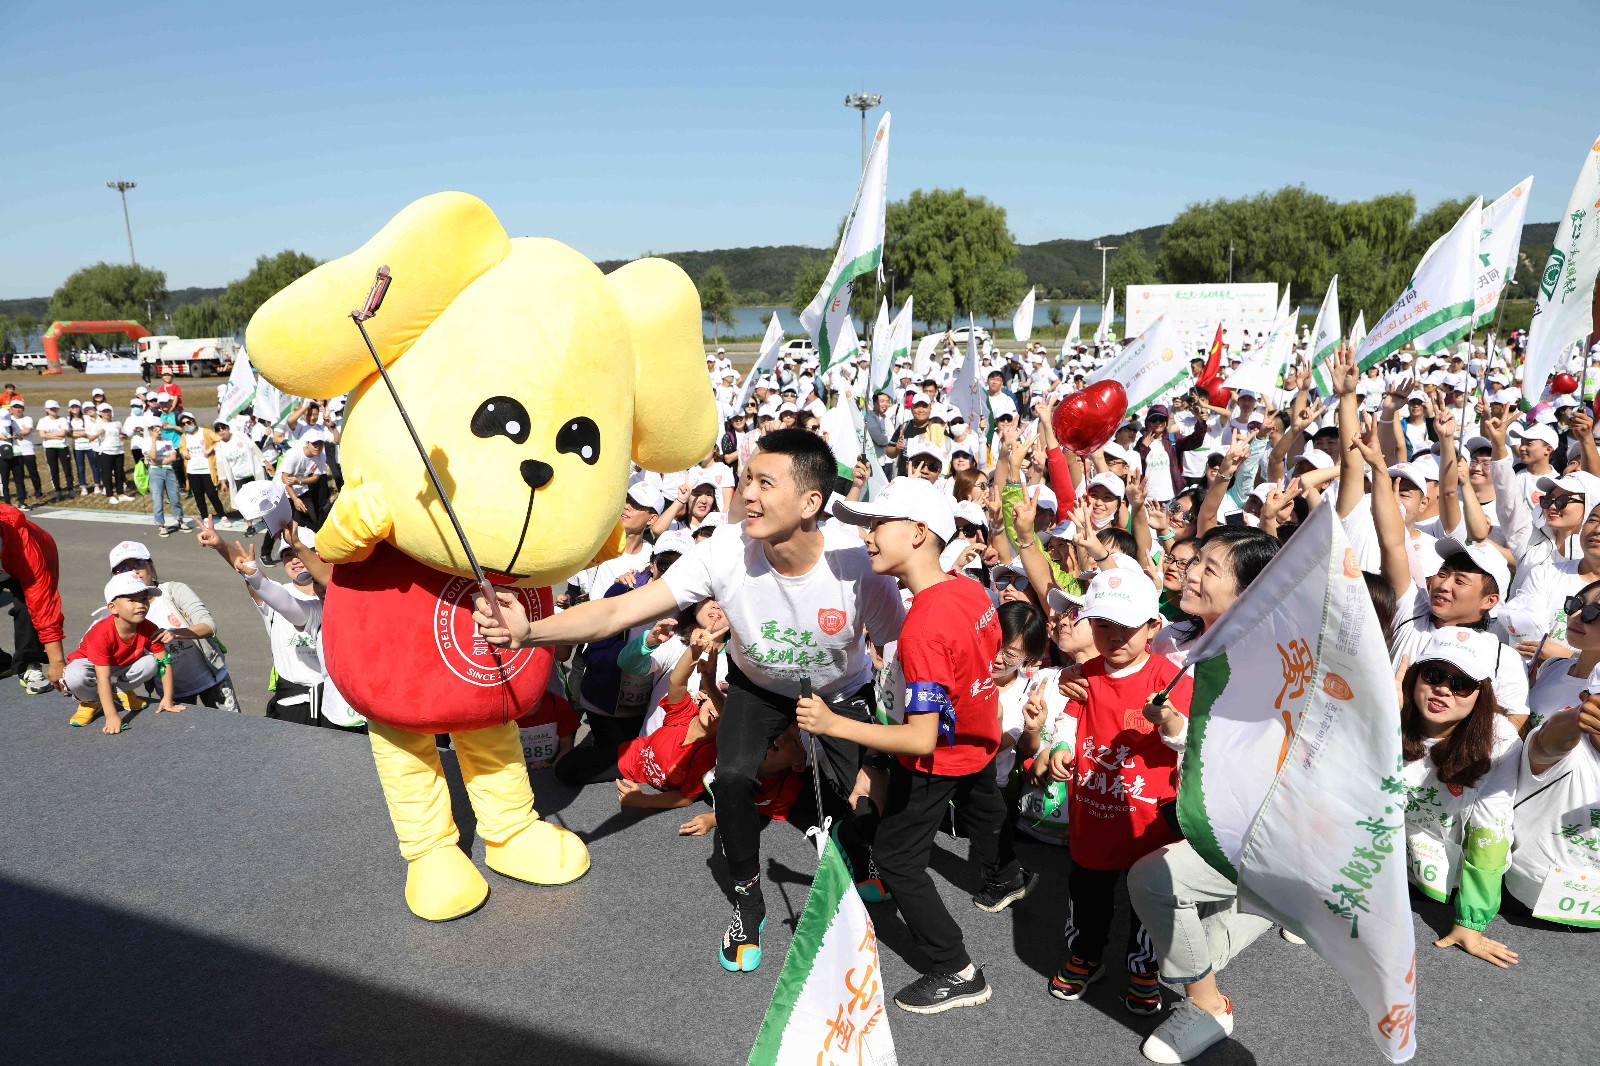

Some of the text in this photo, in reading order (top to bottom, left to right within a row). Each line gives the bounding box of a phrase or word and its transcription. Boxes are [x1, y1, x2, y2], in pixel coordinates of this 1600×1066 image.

[440, 610, 452, 649] DELOS
[761, 620, 818, 648] 爱之光
[467, 668, 496, 681] SINCE
[1082, 736, 1136, 771] 爱之光
